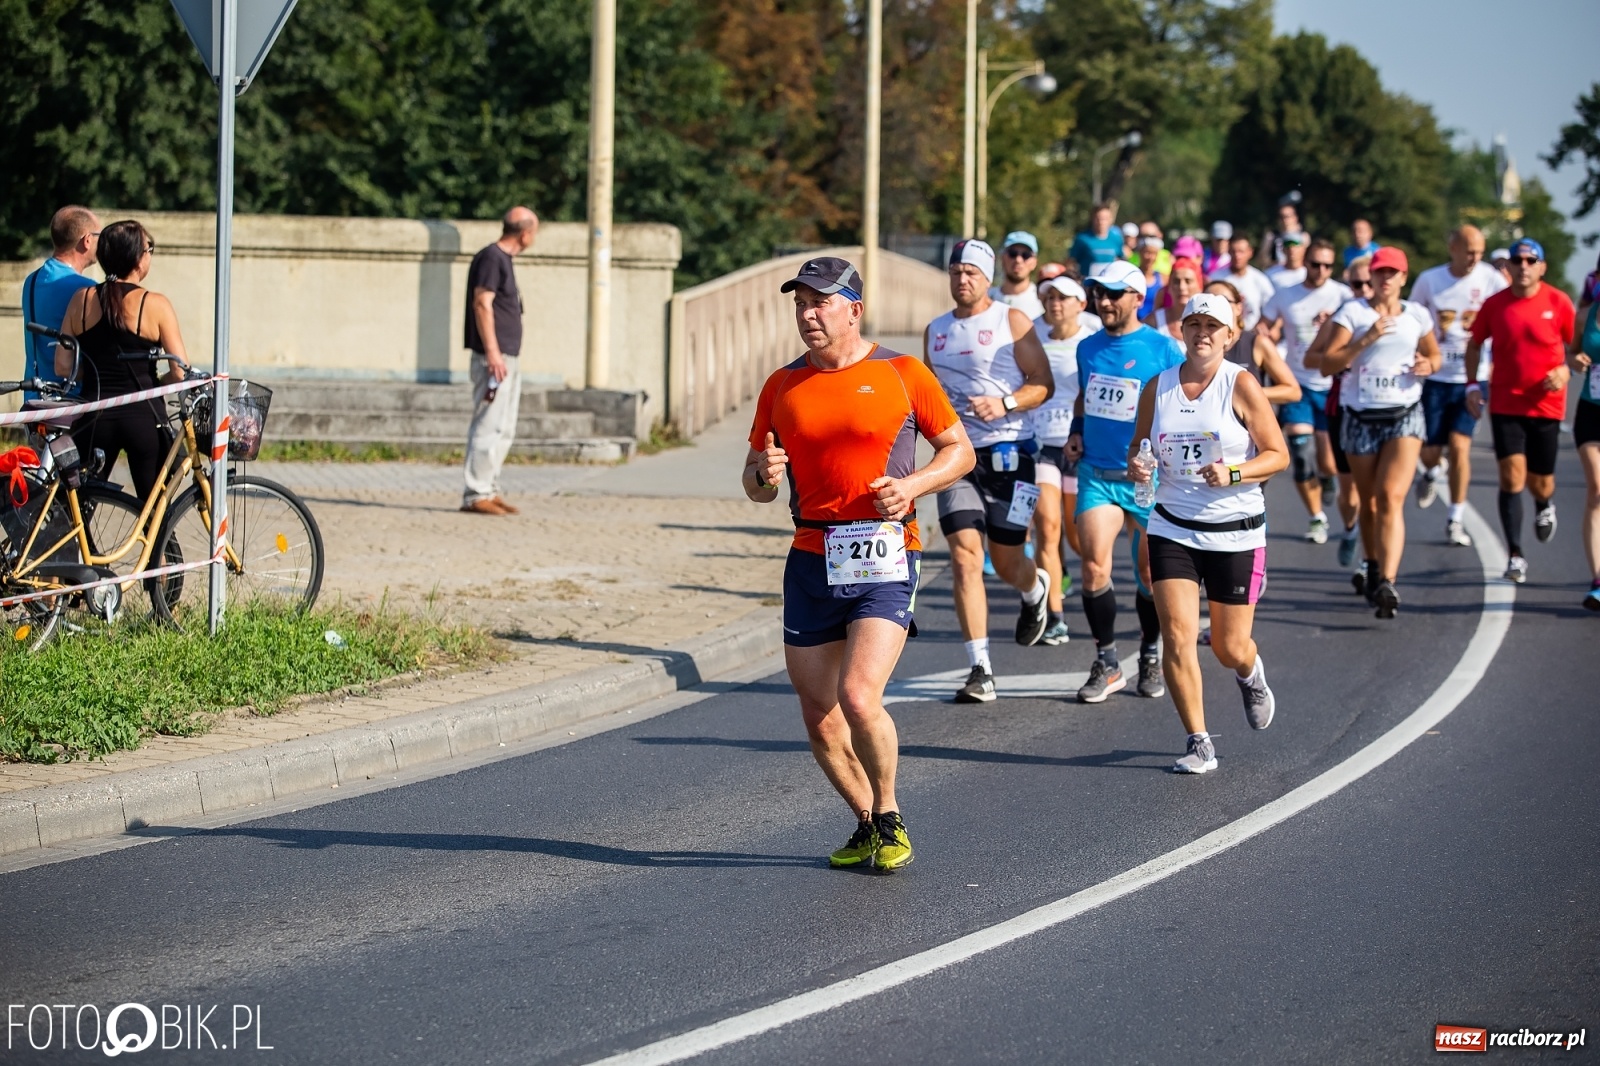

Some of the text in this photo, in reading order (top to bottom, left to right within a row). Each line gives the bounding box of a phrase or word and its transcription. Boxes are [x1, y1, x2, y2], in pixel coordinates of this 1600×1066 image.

[1098, 387, 1125, 403] 219
[1181, 443, 1202, 460] 75
[849, 538, 888, 560] 270
